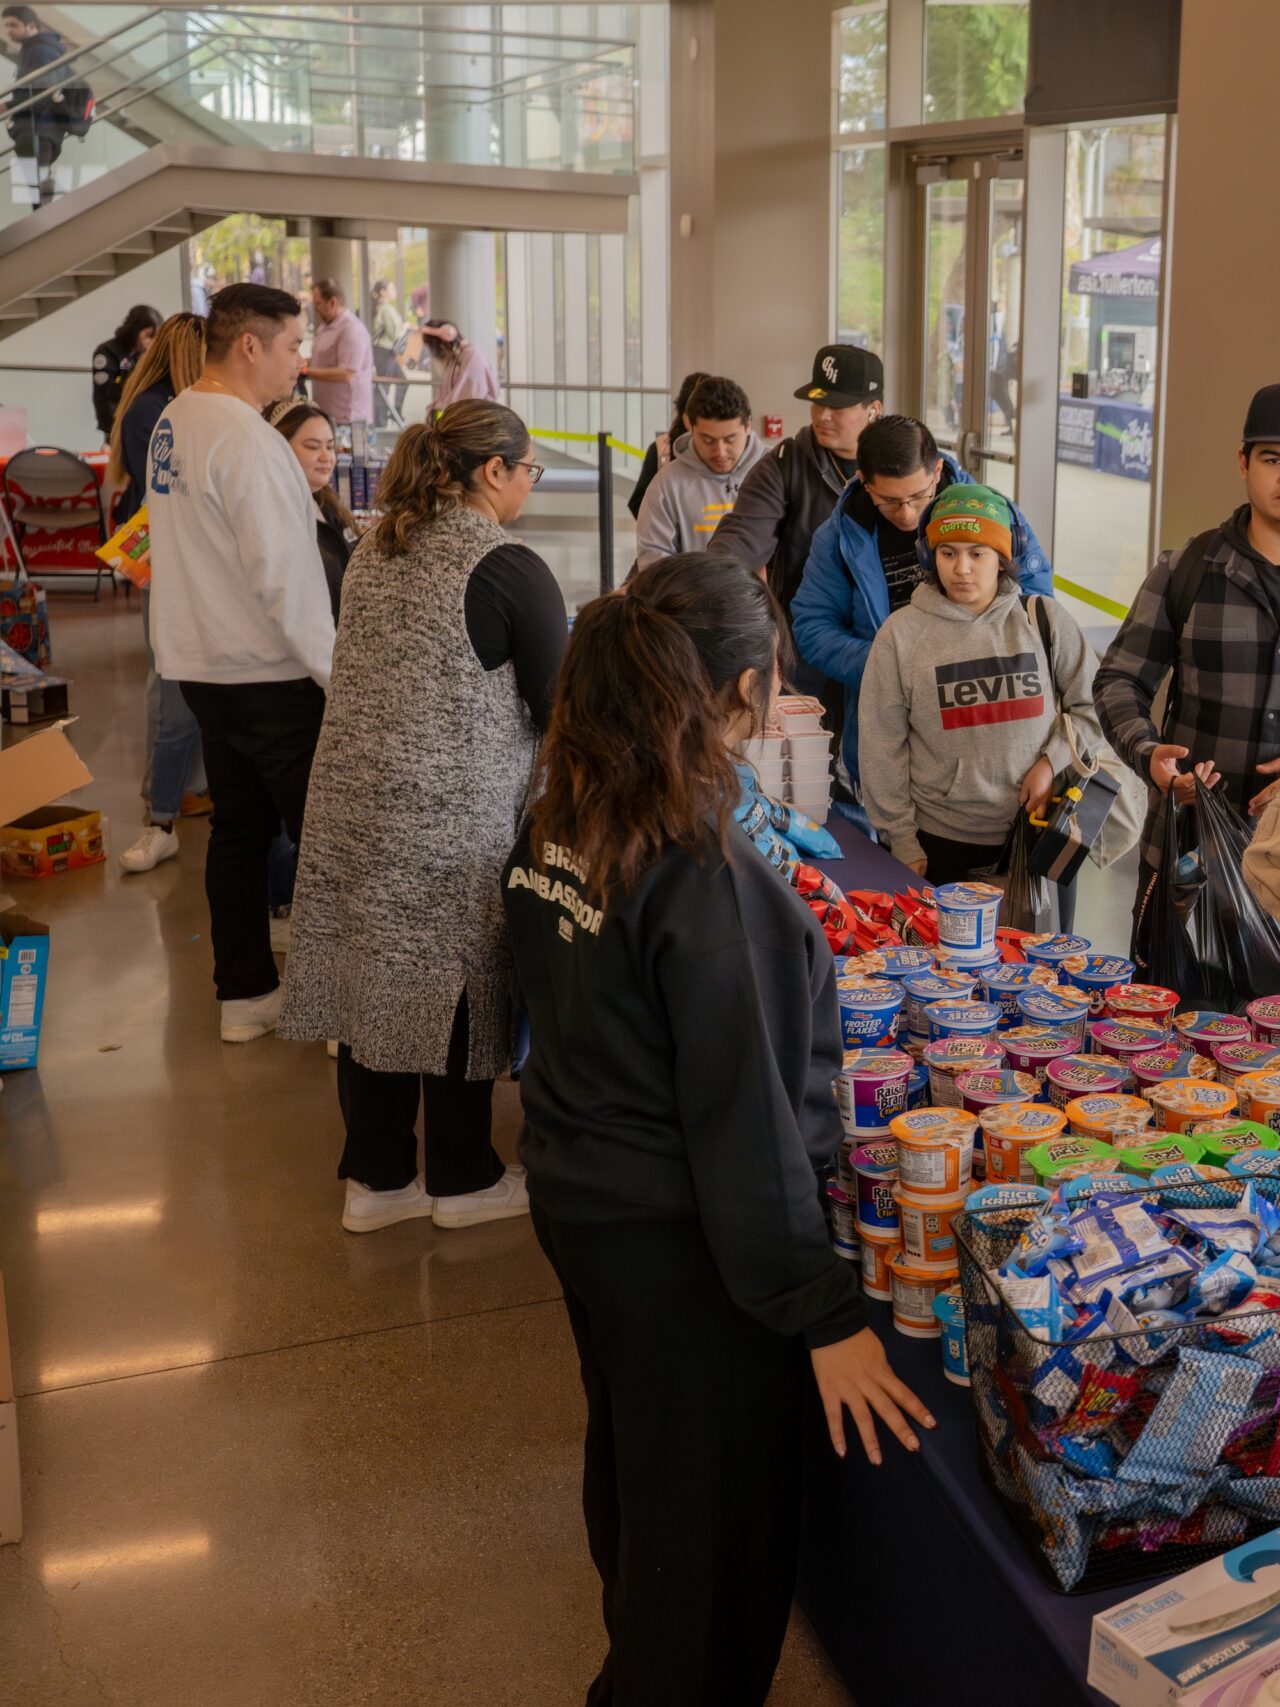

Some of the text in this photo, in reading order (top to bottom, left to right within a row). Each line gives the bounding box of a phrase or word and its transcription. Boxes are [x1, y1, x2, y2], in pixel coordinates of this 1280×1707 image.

[845, 1018, 882, 1029] FROSTED
[846, 1026, 878, 1035] FLAKES
[876, 1084, 906, 1099] Raisin
[880, 1095, 906, 1109] Bran
[1092, 1181, 1130, 1189] RICE
[998, 1191, 1038, 1199] RICE
[877, 1199, 898, 1209] Bra
[981, 1198, 1040, 1206] KRISPI
[1141, 1591, 1185, 1614] GLOVES
